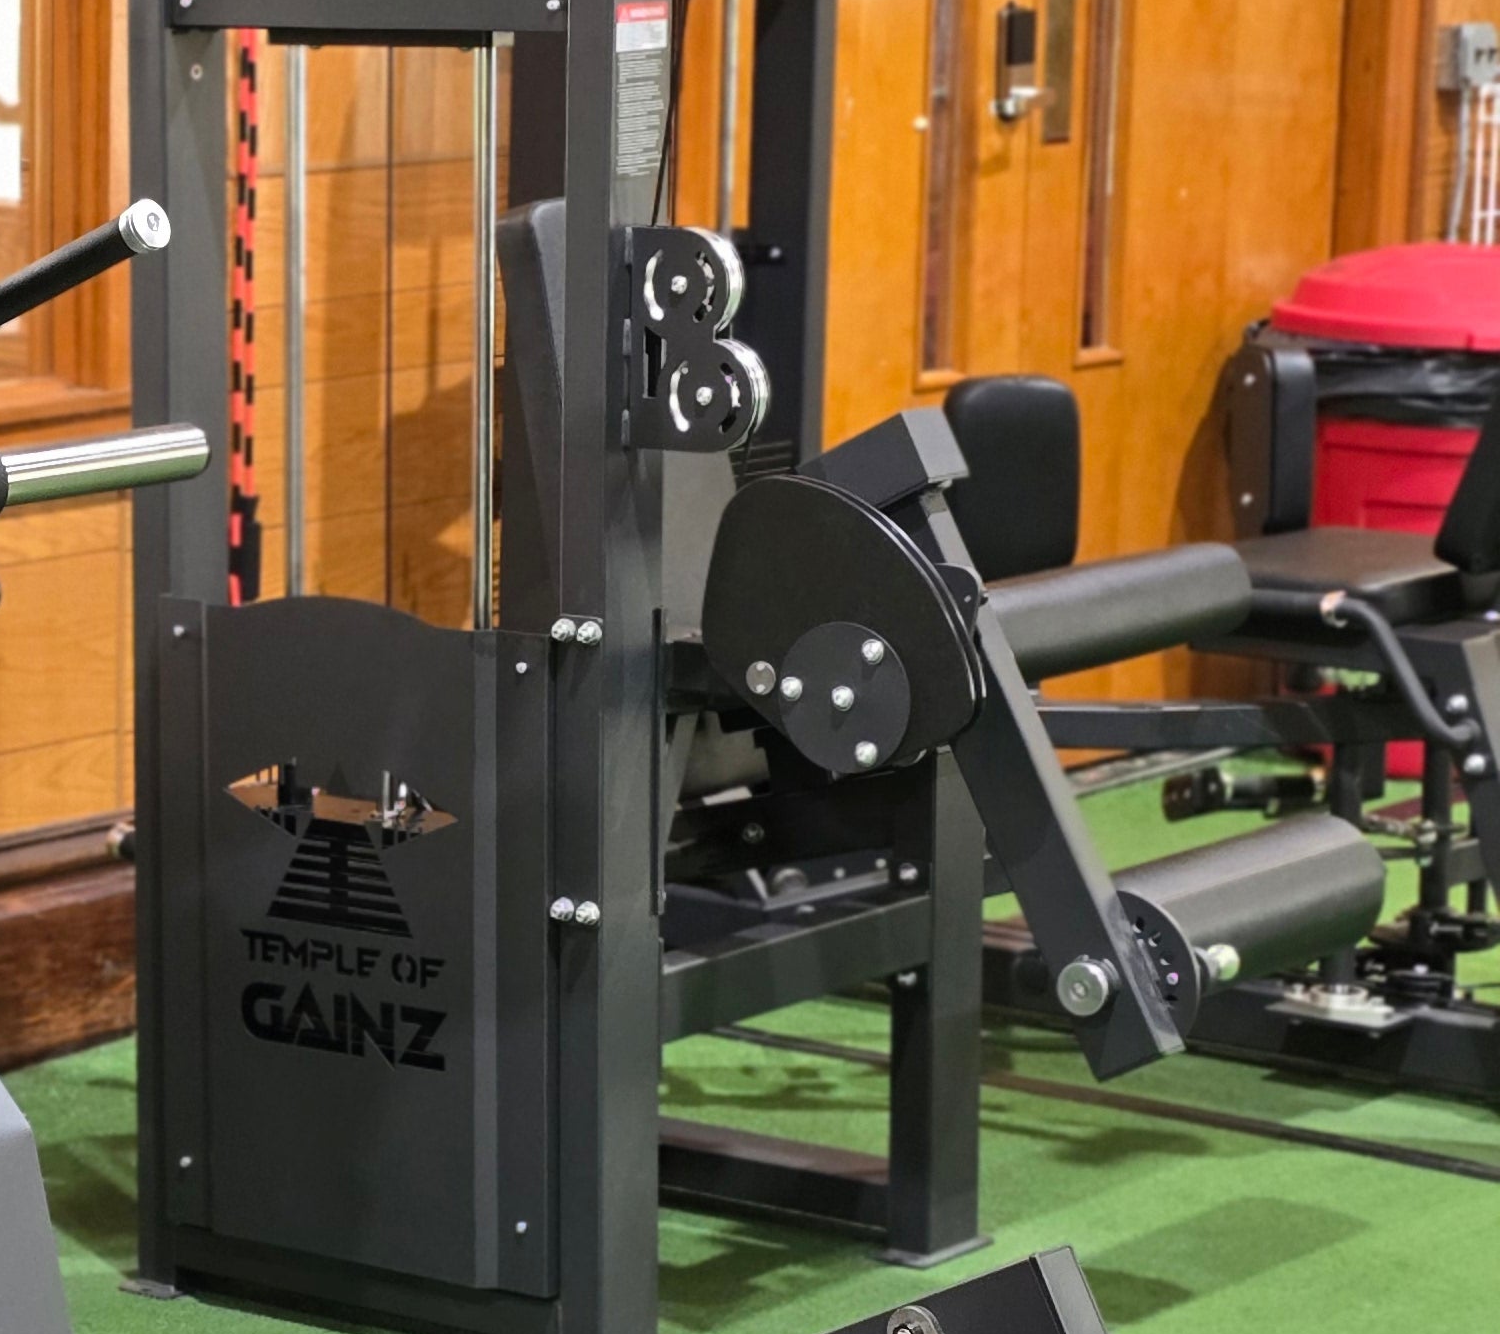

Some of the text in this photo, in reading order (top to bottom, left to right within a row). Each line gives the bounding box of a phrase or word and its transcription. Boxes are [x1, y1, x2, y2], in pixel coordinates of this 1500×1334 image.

[240, 929, 445, 989] TEMPLE OF
[241, 981, 447, 1072] GAINZ
